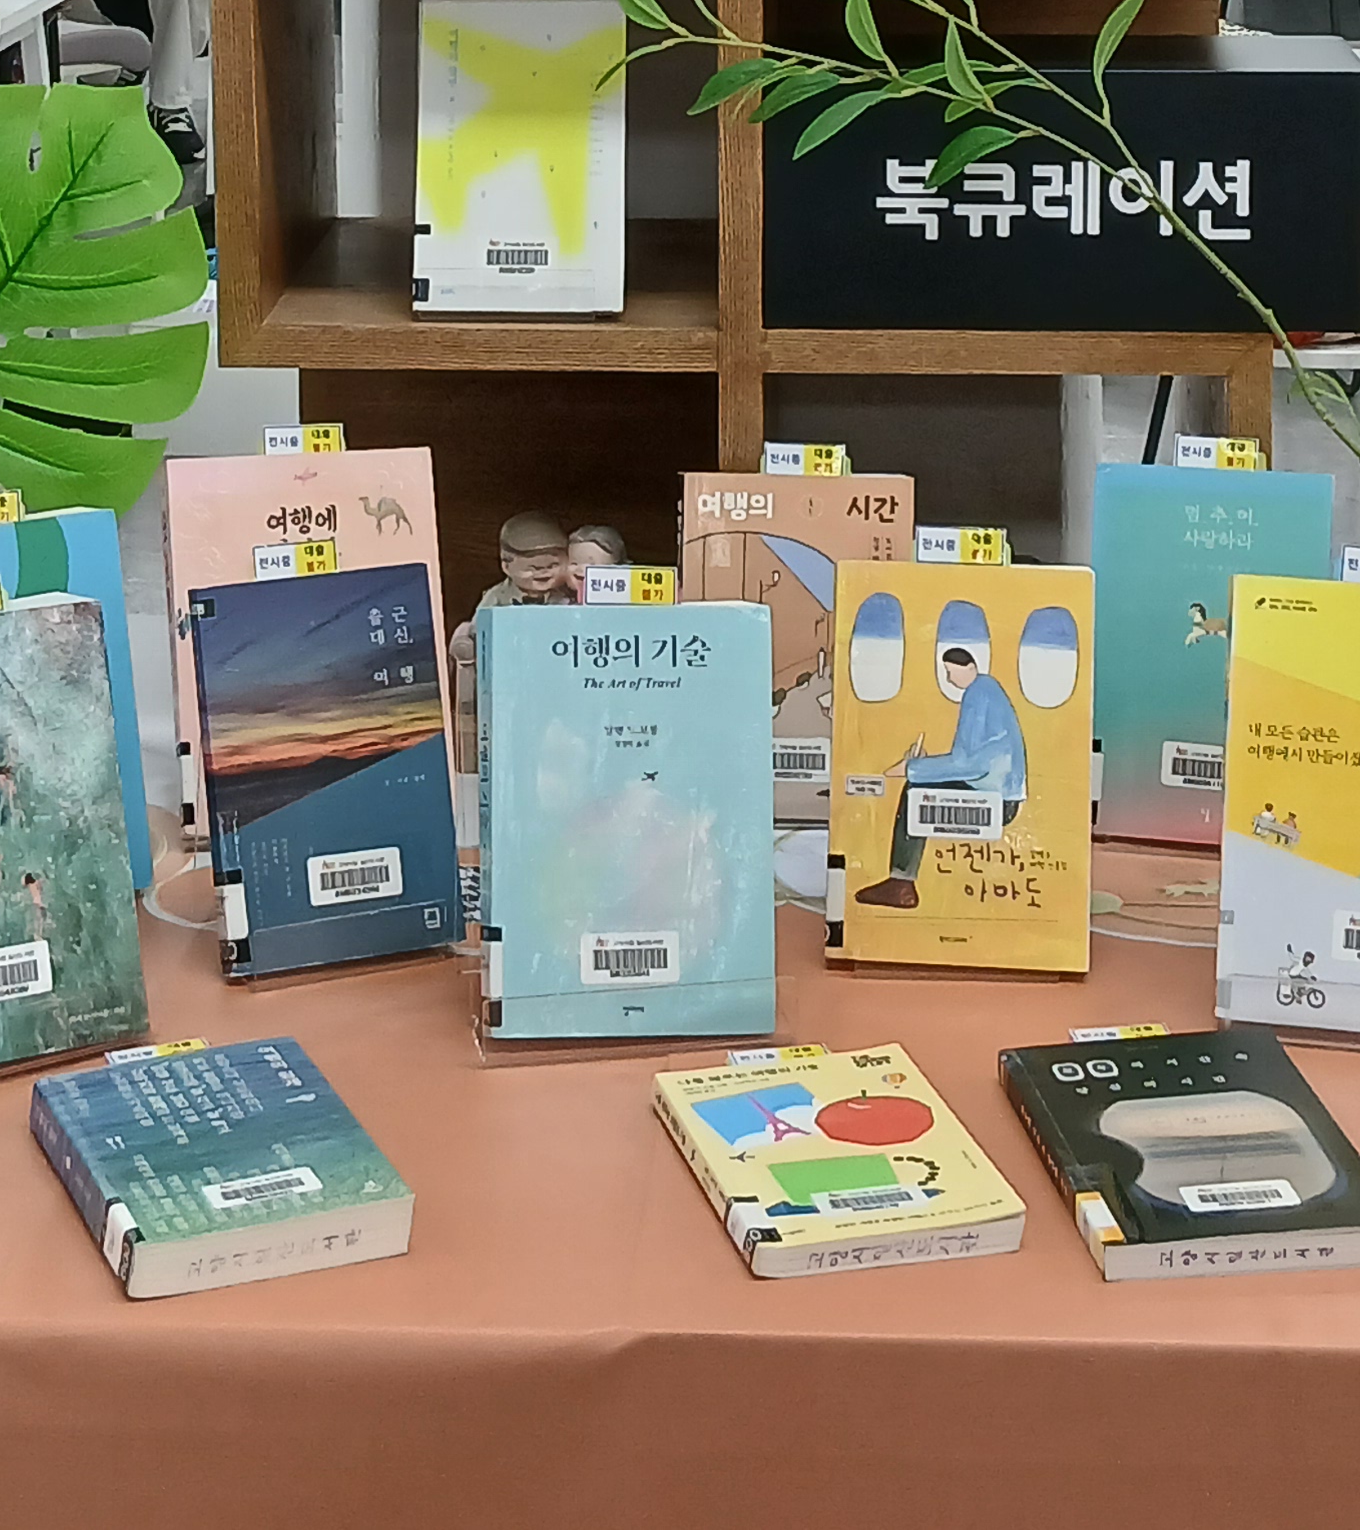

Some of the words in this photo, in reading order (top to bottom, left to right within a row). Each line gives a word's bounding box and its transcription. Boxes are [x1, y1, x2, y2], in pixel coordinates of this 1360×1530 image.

[874, 159, 1252, 242] 북큐레이션
[267, 504, 337, 534] 여행에
[698, 491, 773, 520] 여행의
[846, 495, 899, 524] 시간
[1184, 528, 1254, 551] 사랑하라
[551, 634, 640, 669] 여행의
[650, 634, 711, 669] 기술
[582, 676, 605, 689] The
[608, 676, 627, 689] Art
[630, 676, 642, 690] of
[643, 676, 682, 689] Travel
[1249, 721, 1263, 740] 내
[1266, 723, 1295, 740] 모든
[935, 843, 1025, 873] 언젠가,
[964, 880, 1042, 909] 아마도
